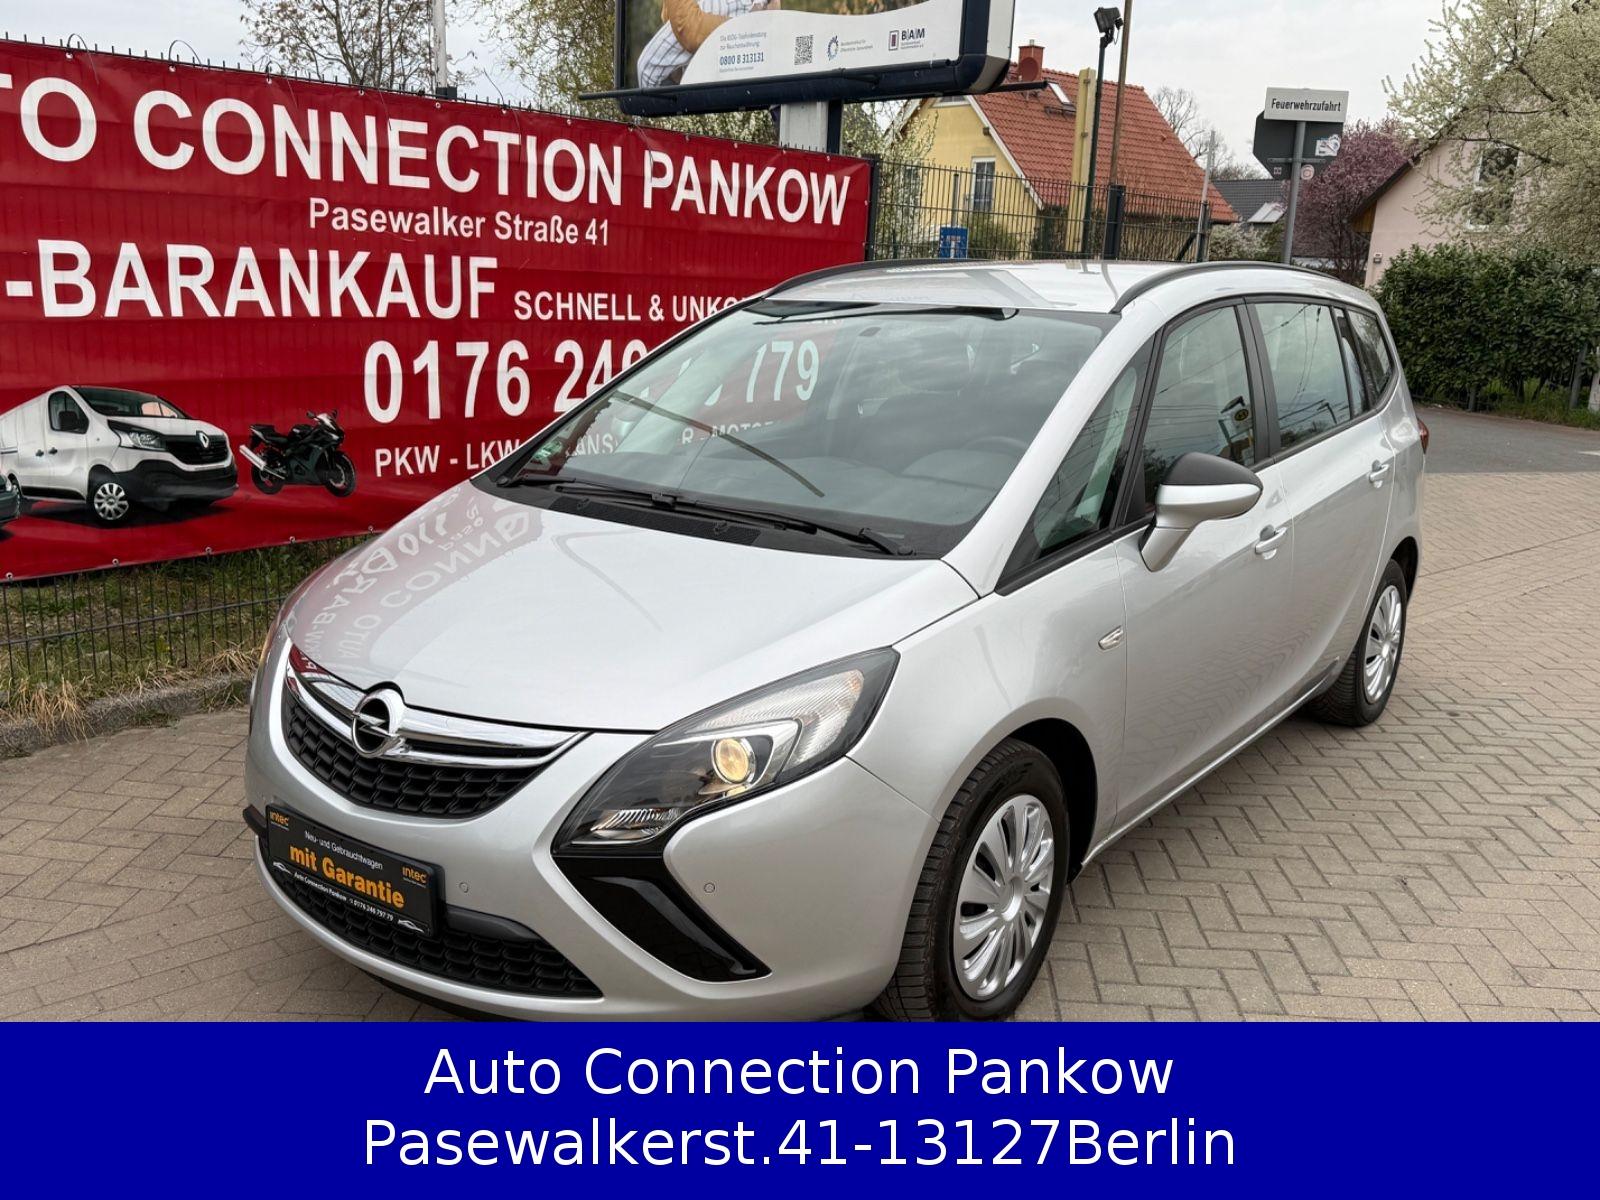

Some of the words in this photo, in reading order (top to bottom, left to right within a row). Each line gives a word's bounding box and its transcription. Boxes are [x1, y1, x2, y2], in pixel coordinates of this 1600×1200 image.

[719, 55, 736, 65] 0800
[736, 54, 741, 64] 8
[742, 51, 764, 63] 313131
[1271, 98, 1341, 112] Feuerwehrzufahrt
[0, 73, 97, 162] O
[134, 90, 622, 206] CONNECTION
[644, 151, 850, 226] PANKOW
[309, 197, 486, 238] Pasewalker
[494, 211, 579, 245] Straße
[585, 219, 609, 246] 41
[514, 290, 641, 321] SCHNELL
[649, 295, 664, 321] &
[364, 340, 530, 423] 0176
[375, 445, 440, 477] PKW
[270, 811, 290, 827] intec
[304, 830, 318, 843] Neu-
[319, 839, 330, 849] und
[331, 843, 383, 870] Gebrauchtwagen
[289, 844, 318, 873] mit
[322, 857, 406, 909] Garantie
[402, 866, 427, 884] intec
